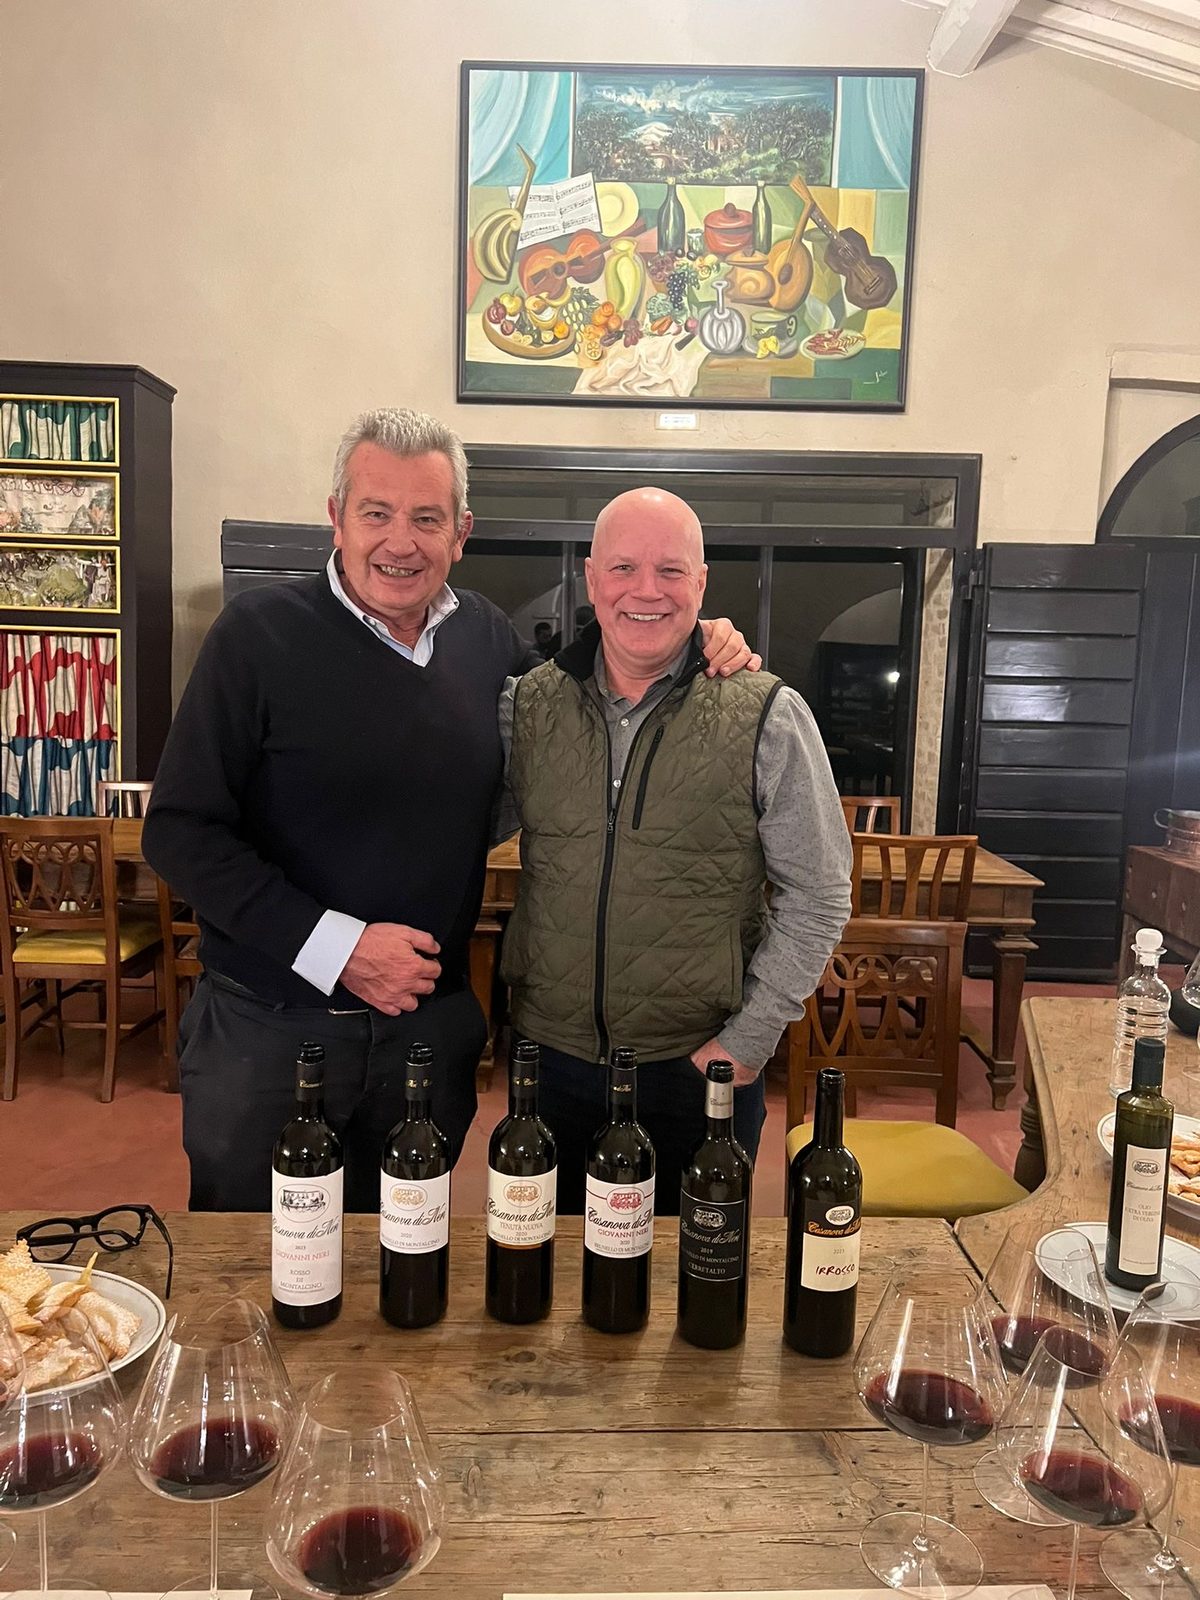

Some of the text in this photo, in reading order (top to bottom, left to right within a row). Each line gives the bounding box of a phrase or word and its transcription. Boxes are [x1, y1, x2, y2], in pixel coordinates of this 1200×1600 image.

[488, 1198, 528, 1222] Casanova
[413, 1212, 424, 1226] di
[588, 1207, 630, 1230] Casanova
[307, 1225, 318, 1239] di
[598, 1229, 635, 1238] GIOVANNI
[280, 1281, 322, 1290] MONTALCINO
